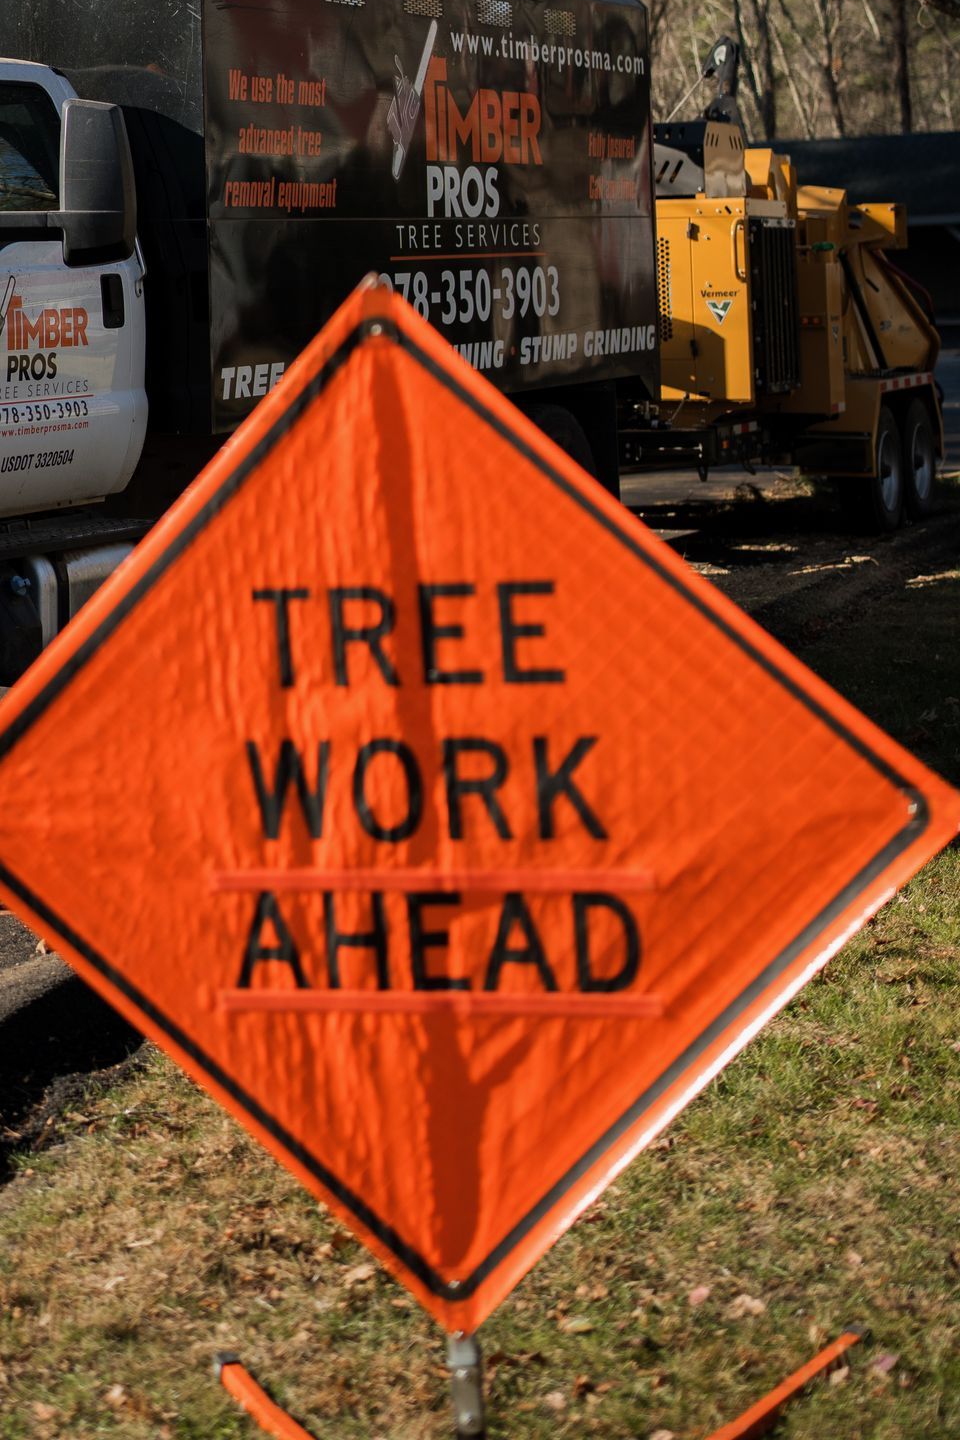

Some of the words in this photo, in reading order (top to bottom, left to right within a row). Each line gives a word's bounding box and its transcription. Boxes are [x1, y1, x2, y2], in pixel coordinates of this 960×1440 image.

[450, 31, 645, 75] www.timberprosma.com
[229, 69, 248, 101] We
[251, 76, 273, 103] use
[276, 73, 295, 104] the
[298, 78, 326, 107] most
[424, 54, 544, 165] TIMBER
[238, 123, 294, 155] advanced
[295, 126, 322, 157] tree
[225, 176, 275, 208] removal
[278, 177, 337, 213] equipment
[426, 165, 501, 218] PROS
[396, 225, 442, 249] TREE
[455, 223, 540, 247] SERVICES
[700, 289, 737, 298] Vermeer
[7, 295, 88, 350] TIMBER
[7, 352, 57, 382] PROS
[221, 362, 285, 400] TREE
[520, 333, 578, 365] STUMP
[583, 325, 656, 358] GRINDING
[27, 380, 89, 397] SERVICES
[1, 454, 35, 473] USDOT
[35, 449, 75, 468] 3320504
[252, 580, 566, 689] TREE
[245, 734, 610, 844] WORK
[236, 890, 643, 994] AHEAD
